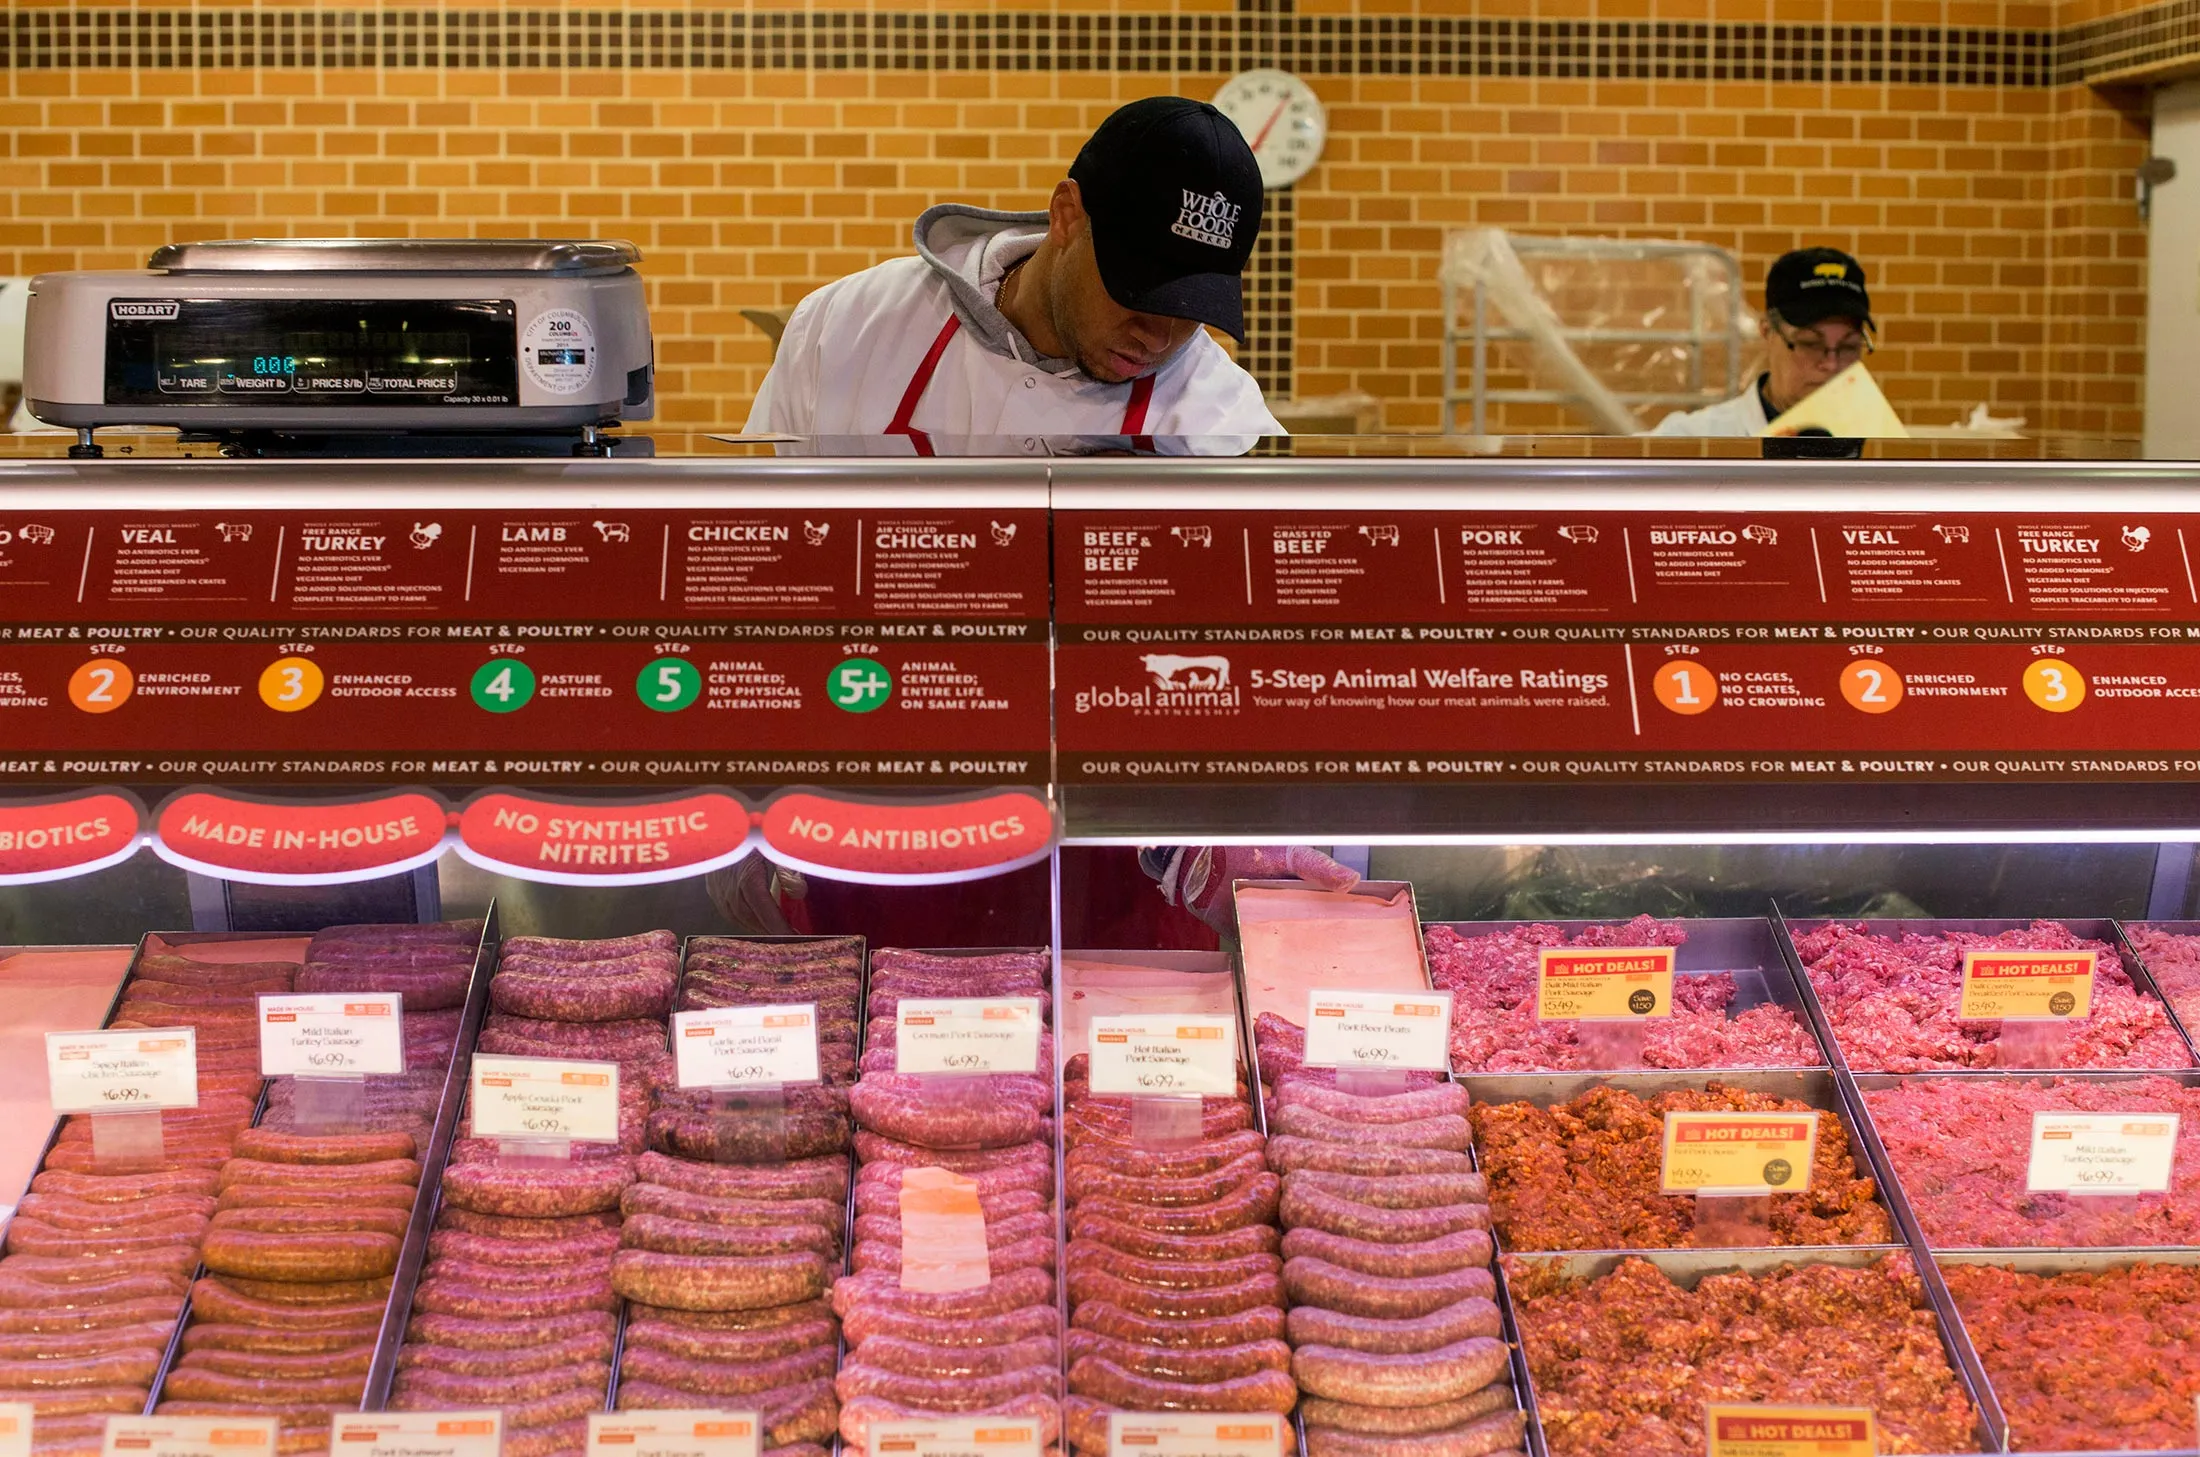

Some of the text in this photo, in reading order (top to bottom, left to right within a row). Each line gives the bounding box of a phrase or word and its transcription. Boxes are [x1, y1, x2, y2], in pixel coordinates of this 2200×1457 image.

[1182, 190, 1242, 223] WHOLE
[1177, 207, 1235, 239] FOODS
[1173, 225, 1230, 248] MARKET
[118, 305, 173, 315] HOBART
[549, 321, 571, 331] 200
[180, 378, 207, 388] TARE
[237, 378, 286, 388] WEIGHT lb
[312, 379, 363, 388] PRICE $/lb
[384, 379, 454, 388] TOTAL PRICE $
[122, 530, 176, 543] VEAL
[502, 528, 566, 541] LAMB
[689, 527, 788, 540] CHICKEN
[1085, 532, 1151, 547] BEEF &
[1462, 531, 1522, 544] PORK
[1651, 531, 1736, 544] BUFFALO
[1843, 531, 1899, 544] VEAL
[302, 537, 385, 550] TURKEY
[876, 534, 976, 548] CHICKEN
[1274, 540, 1326, 553] BEEF
[2019, 539, 2099, 552] TURKEY
[1085, 557, 1138, 571] BEEF
[18, 628, 64, 638] MEAT
[69, 627, 80, 638] &
[88, 628, 162, 638] POULTRY
[181, 628, 217, 637] OUR
[223, 628, 295, 640] QUALITY
[301, 627, 400, 637] STANDARDS
[408, 627, 440, 637] FOR
[448, 627, 493, 636] MEAT
[498, 626, 510, 636] &
[518, 626, 593, 636] POULTRY
[613, 626, 649, 636] OUR
[655, 626, 727, 638] QUALITY
[735, 626, 834, 636] STANDARDS
[841, 626, 874, 636] FOR
[881, 626, 926, 635] MEAT
[933, 625, 944, 636] &
[952, 625, 1026, 636] POULTRY
[90, 644, 125, 654] STEP
[279, 643, 314, 653] STEP
[490, 644, 525, 654] STEP
[655, 643, 690, 654] STEP
[843, 644, 878, 654] STEP
[1665, 645, 1699, 655] STEP
[1849, 644, 1883, 655] STEP
[2031, 645, 2065, 655] STEP
[710, 662, 764, 670] ANIMAL
[902, 663, 956, 671] ANIMAL
[139, 674, 210, 682] ENRICHED
[279, 668, 302, 700] 3
[334, 675, 412, 684] ENHANCED
[542, 675, 601, 684] PASTURE
[656, 667, 681, 701] 5
[709, 674, 784, 685] CENTERED;
[902, 675, 977, 685] CENTERED;
[1251, 668, 1608, 693] 5-Step Animal Welfare Ratings
[1720, 673, 1792, 683] NO CAGES,
[1906, 675, 1975, 683] ENRICHED
[2093, 676, 2167, 684] ENHANCED
[87, 669, 114, 701] 2
[485, 668, 514, 701] 4
[839, 669, 887, 704] 5+
[1672, 671, 1699, 703] 1
[1722, 685, 1800, 695] NO CRATES,
[1857, 669, 1886, 702] 2
[2041, 669, 2066, 701] 3
[137, 687, 241, 695] ENVIRONMENT
[332, 688, 456, 696] OUTDOOR ACCESS
[540, 688, 612, 696] CENTERED
[709, 687, 801, 696] NO PHYSICAL
[902, 687, 984, 697] ENTIRE LIFE
[1908, 687, 2007, 695] ENVIRONMENT
[2095, 689, 2161, 697] OUTDOOR
[707, 700, 801, 709] ALTERATIONS
[901, 700, 1008, 709] ON SAME FARM
[1076, 686, 1240, 714] global animal
[1253, 695, 1609, 709] Your way of knowing how our meat animals were raised.
[1723, 698, 1825, 706] NO CROWDING
[493, 808, 708, 841] NO SYNTHETIC
[182, 815, 420, 849] MADE IN-HOUSE
[789, 816, 1024, 850] NO ANTIBIOTICS
[539, 841, 669, 864] NITRITES
[1573, 960, 1655, 973] HOT DEALS!
[1999, 963, 2078, 976] HOT DEALS!
[1705, 1127, 1794, 1140] HOT DEALS!
[1752, 1425, 1852, 1438] HOT DEALS!
